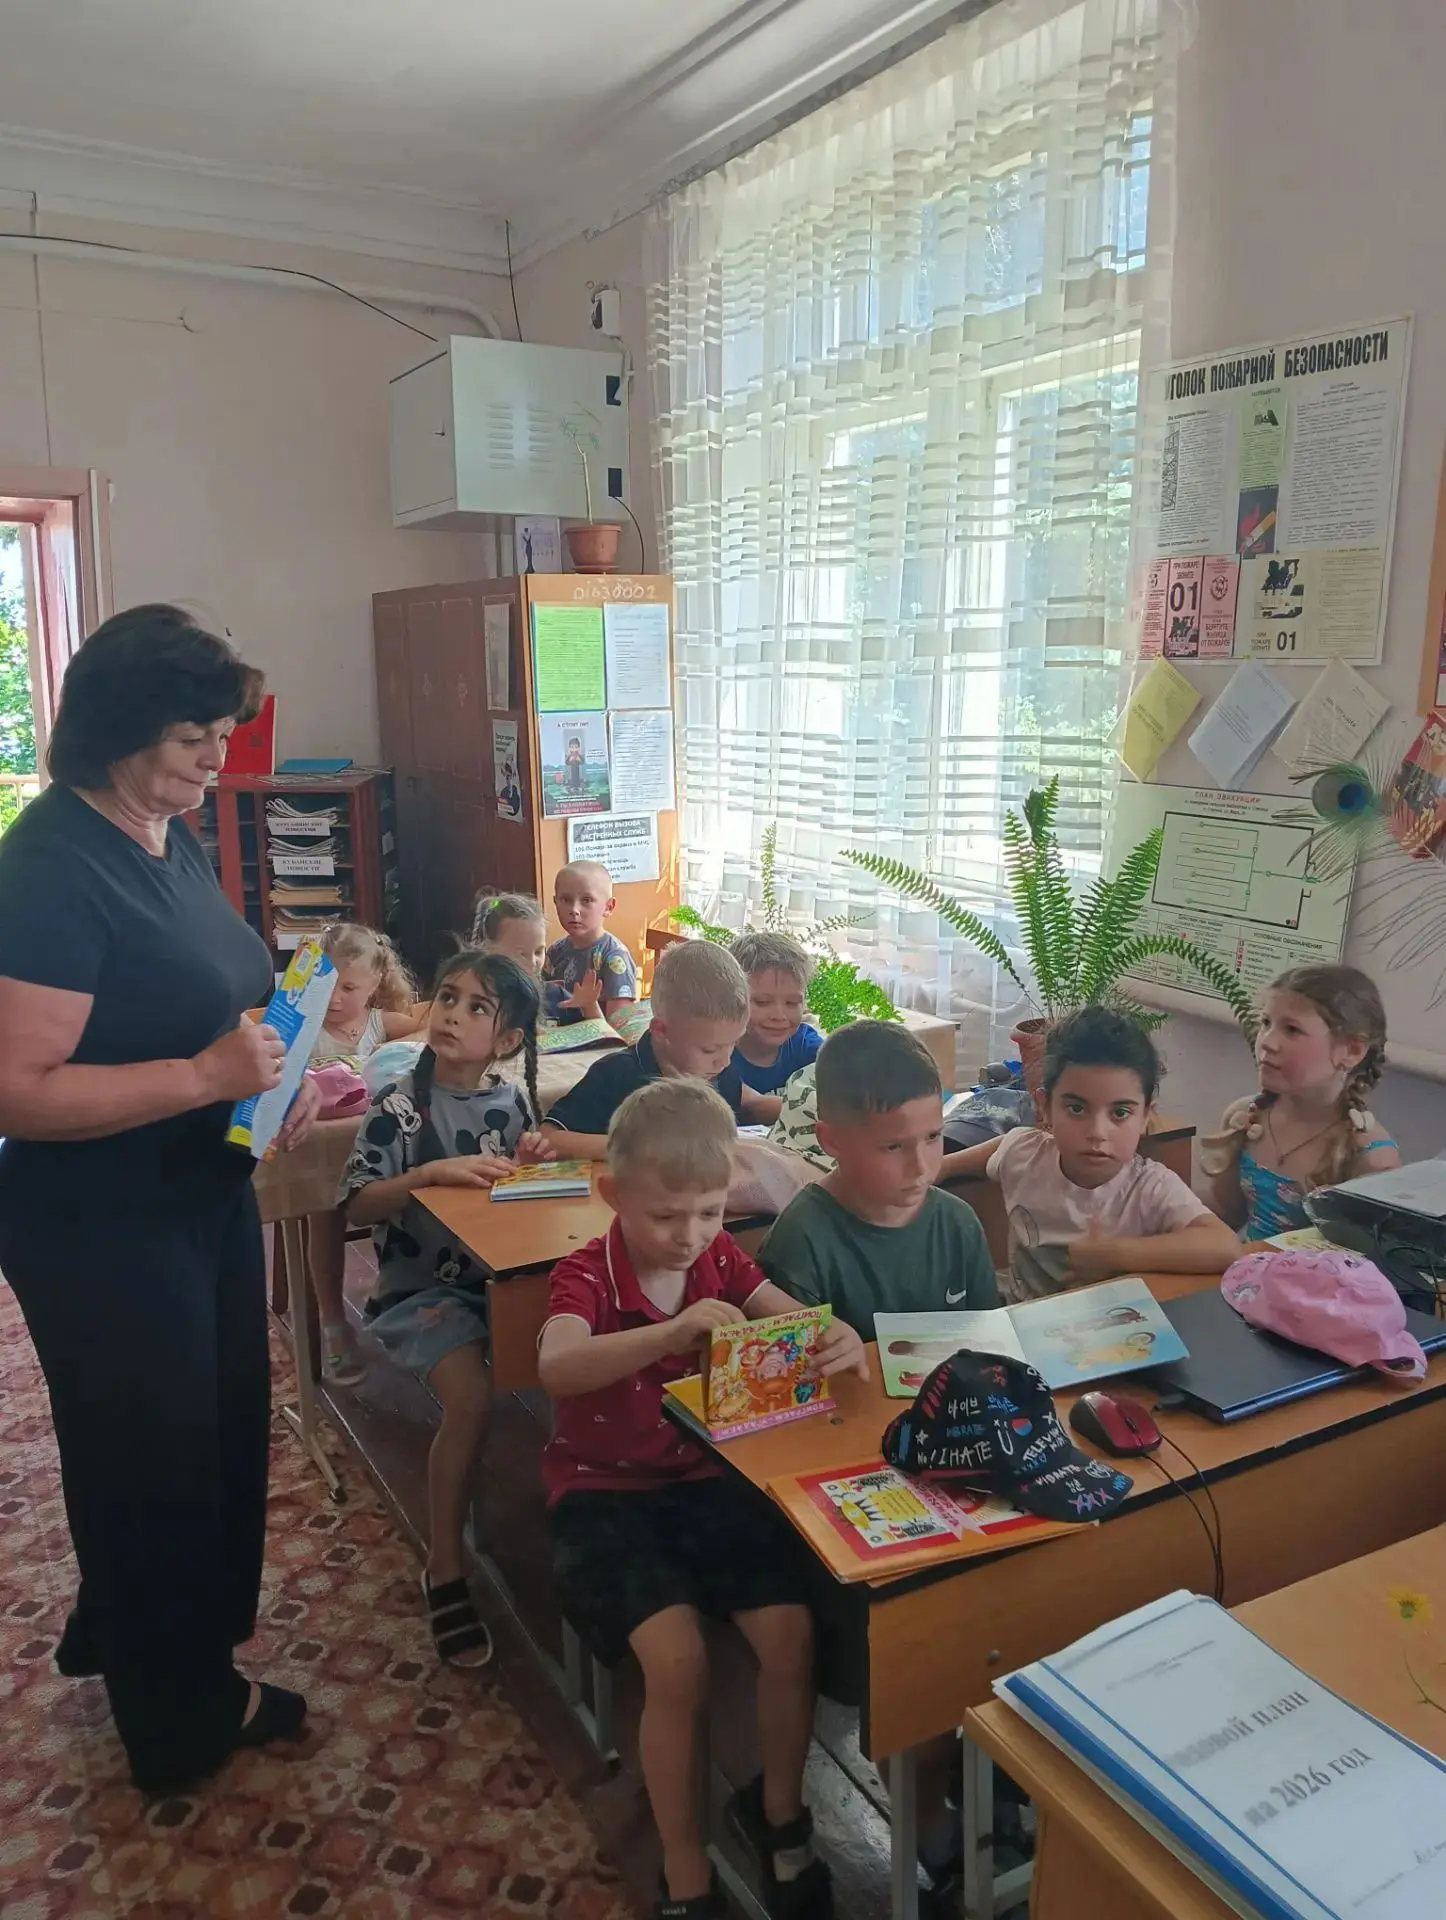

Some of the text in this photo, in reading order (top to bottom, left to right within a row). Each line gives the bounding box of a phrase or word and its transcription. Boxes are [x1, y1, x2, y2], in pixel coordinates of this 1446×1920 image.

[1210, 347, 1277, 393] ПОЖАРНОЙ
[1284, 331, 1389, 378] БЕЗОПАСНОСТИ
[1169, 581, 1198, 612] 01
[1276, 630, 1297, 651] 01
[949, 1440, 993, 1468] HATE
[1253, 1690, 1311, 1729] план
[1268, 1763, 1333, 1811] 2026
[1328, 1745, 1376, 1784] год
